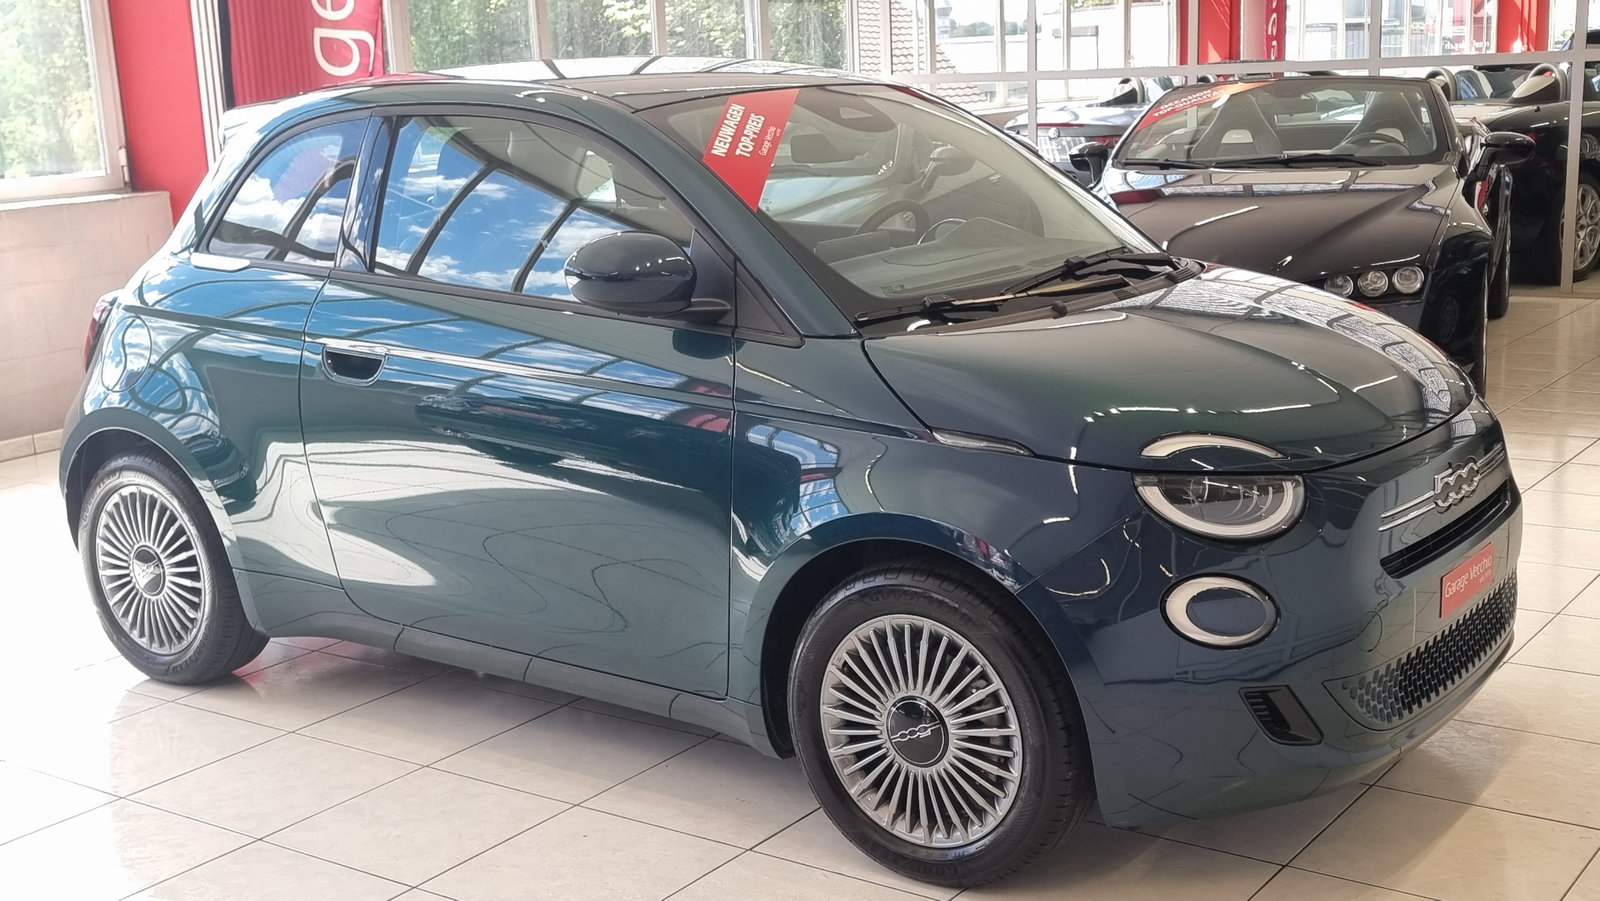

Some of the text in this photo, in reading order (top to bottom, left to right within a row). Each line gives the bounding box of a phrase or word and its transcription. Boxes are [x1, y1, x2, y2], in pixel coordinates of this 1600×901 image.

[1159, 89, 1212, 110] OCCASION
[711, 103, 746, 157] NEUWAGEN
[735, 113, 765, 157] TOP-PREIS
[1434, 462, 1480, 507] 500
[1445, 572, 1469, 598] Garage
